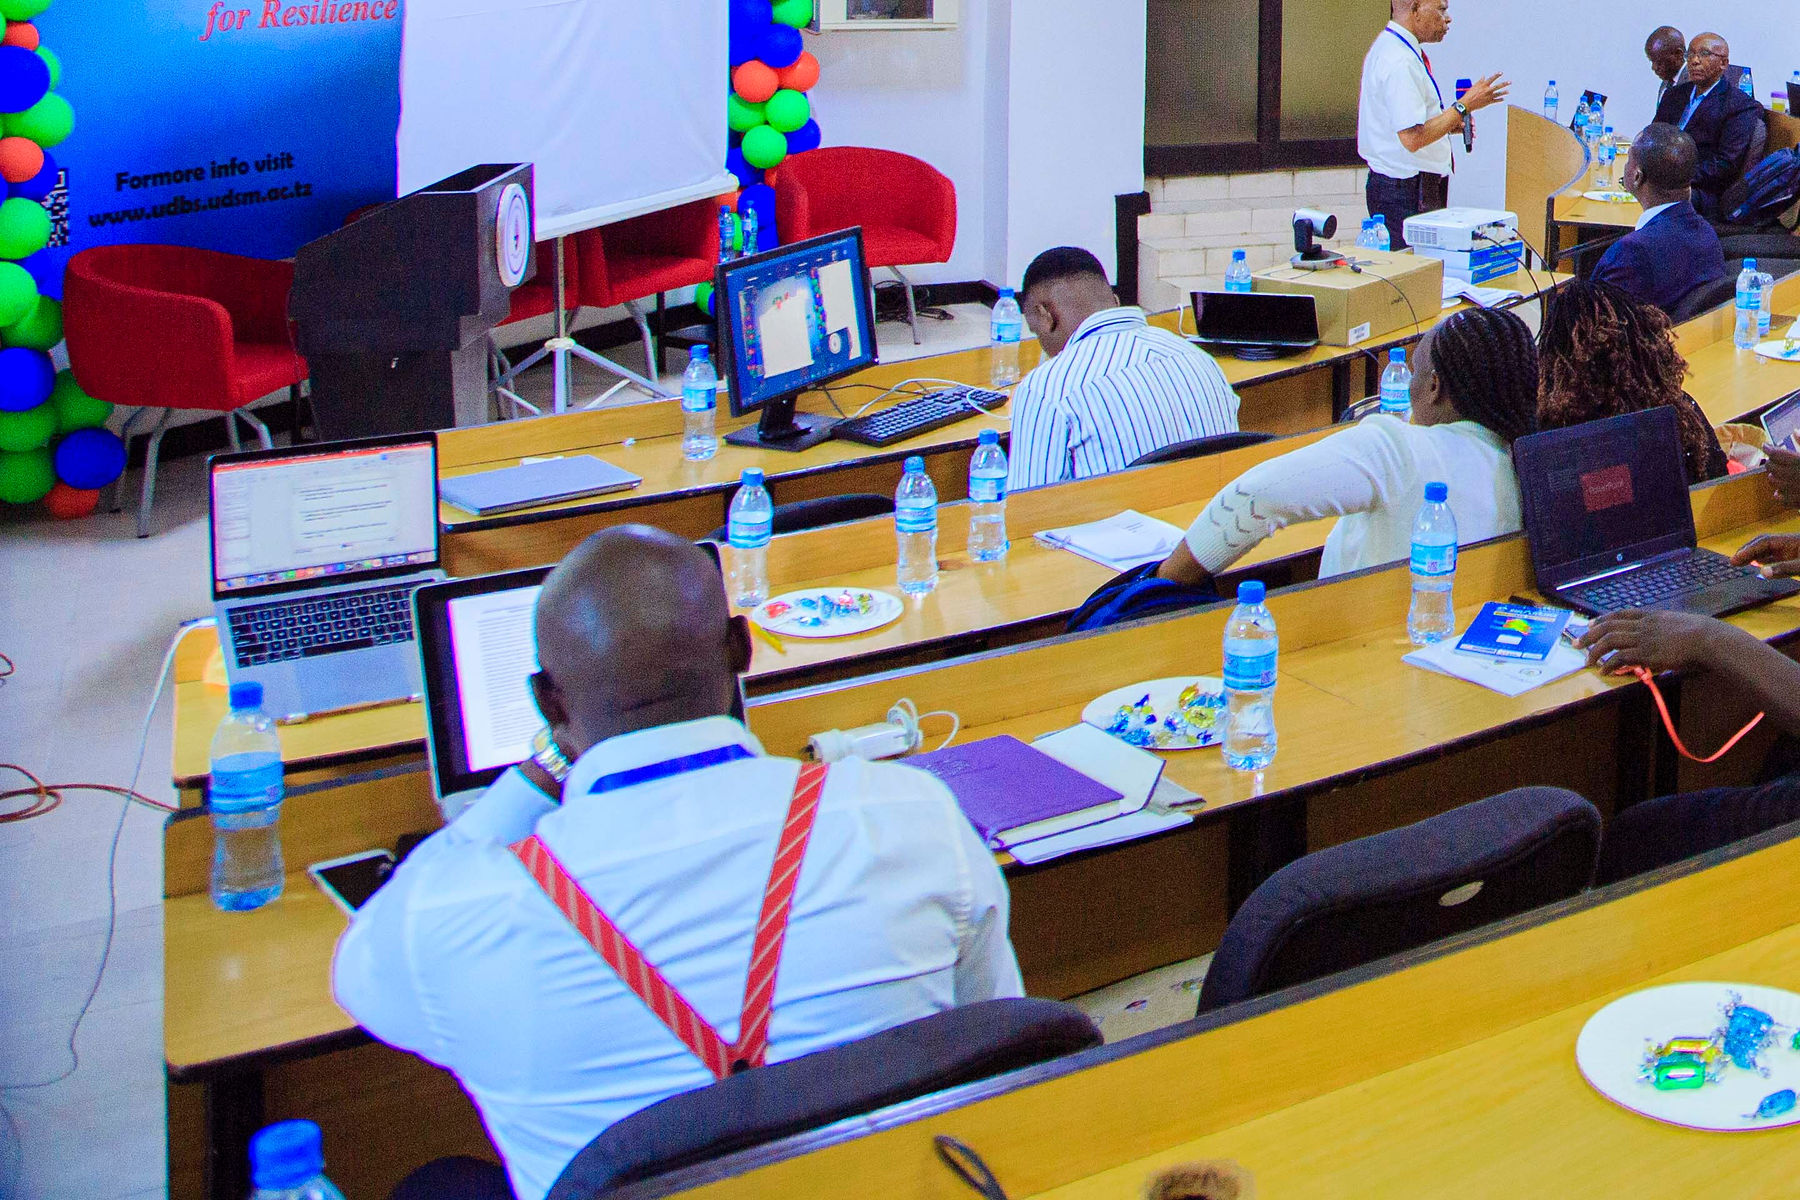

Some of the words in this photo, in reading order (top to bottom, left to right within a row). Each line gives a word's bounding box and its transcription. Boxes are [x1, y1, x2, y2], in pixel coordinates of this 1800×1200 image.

[199, 1, 250, 41] for
[115, 165, 205, 192] Formore
[210, 157, 250, 180] info
[254, 151, 295, 173] visit
[88, 181, 313, 227] www.udbs.udsm.ac.tz
